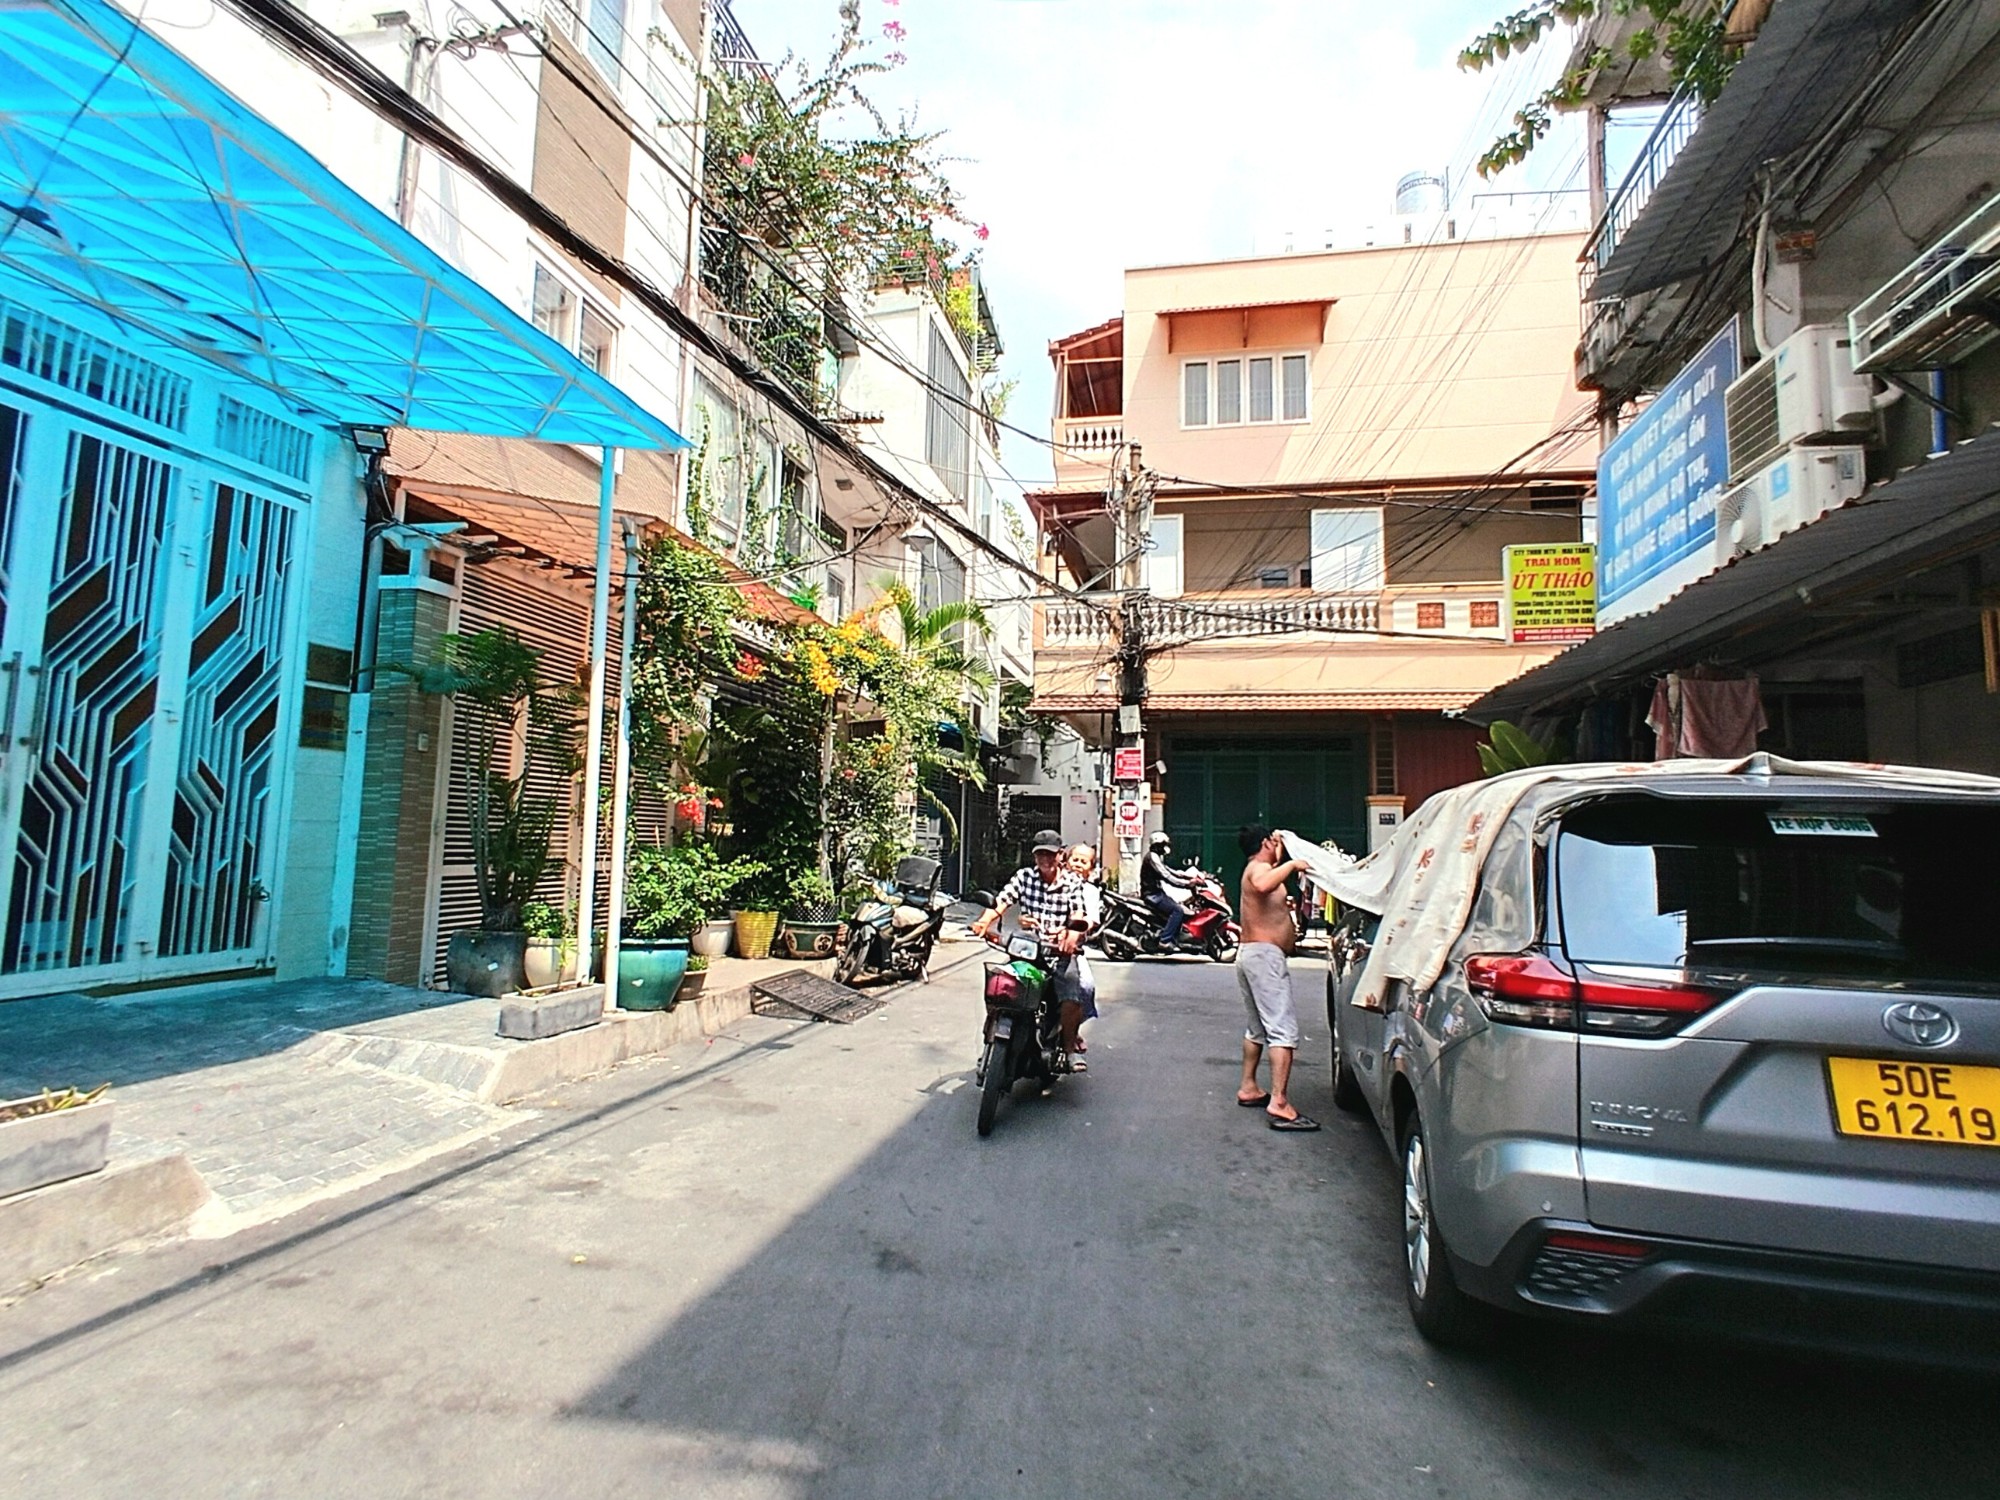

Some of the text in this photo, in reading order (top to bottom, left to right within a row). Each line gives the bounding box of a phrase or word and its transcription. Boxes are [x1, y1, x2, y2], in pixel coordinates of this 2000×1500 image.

[1512, 567, 1594, 590] ÚT THẢO
[1121, 805, 1138, 817] STOP
[1772, 818, 1794, 830] XE
[1878, 1063, 1957, 1101] 50E
[1856, 1099, 1997, 1141] 612.19
